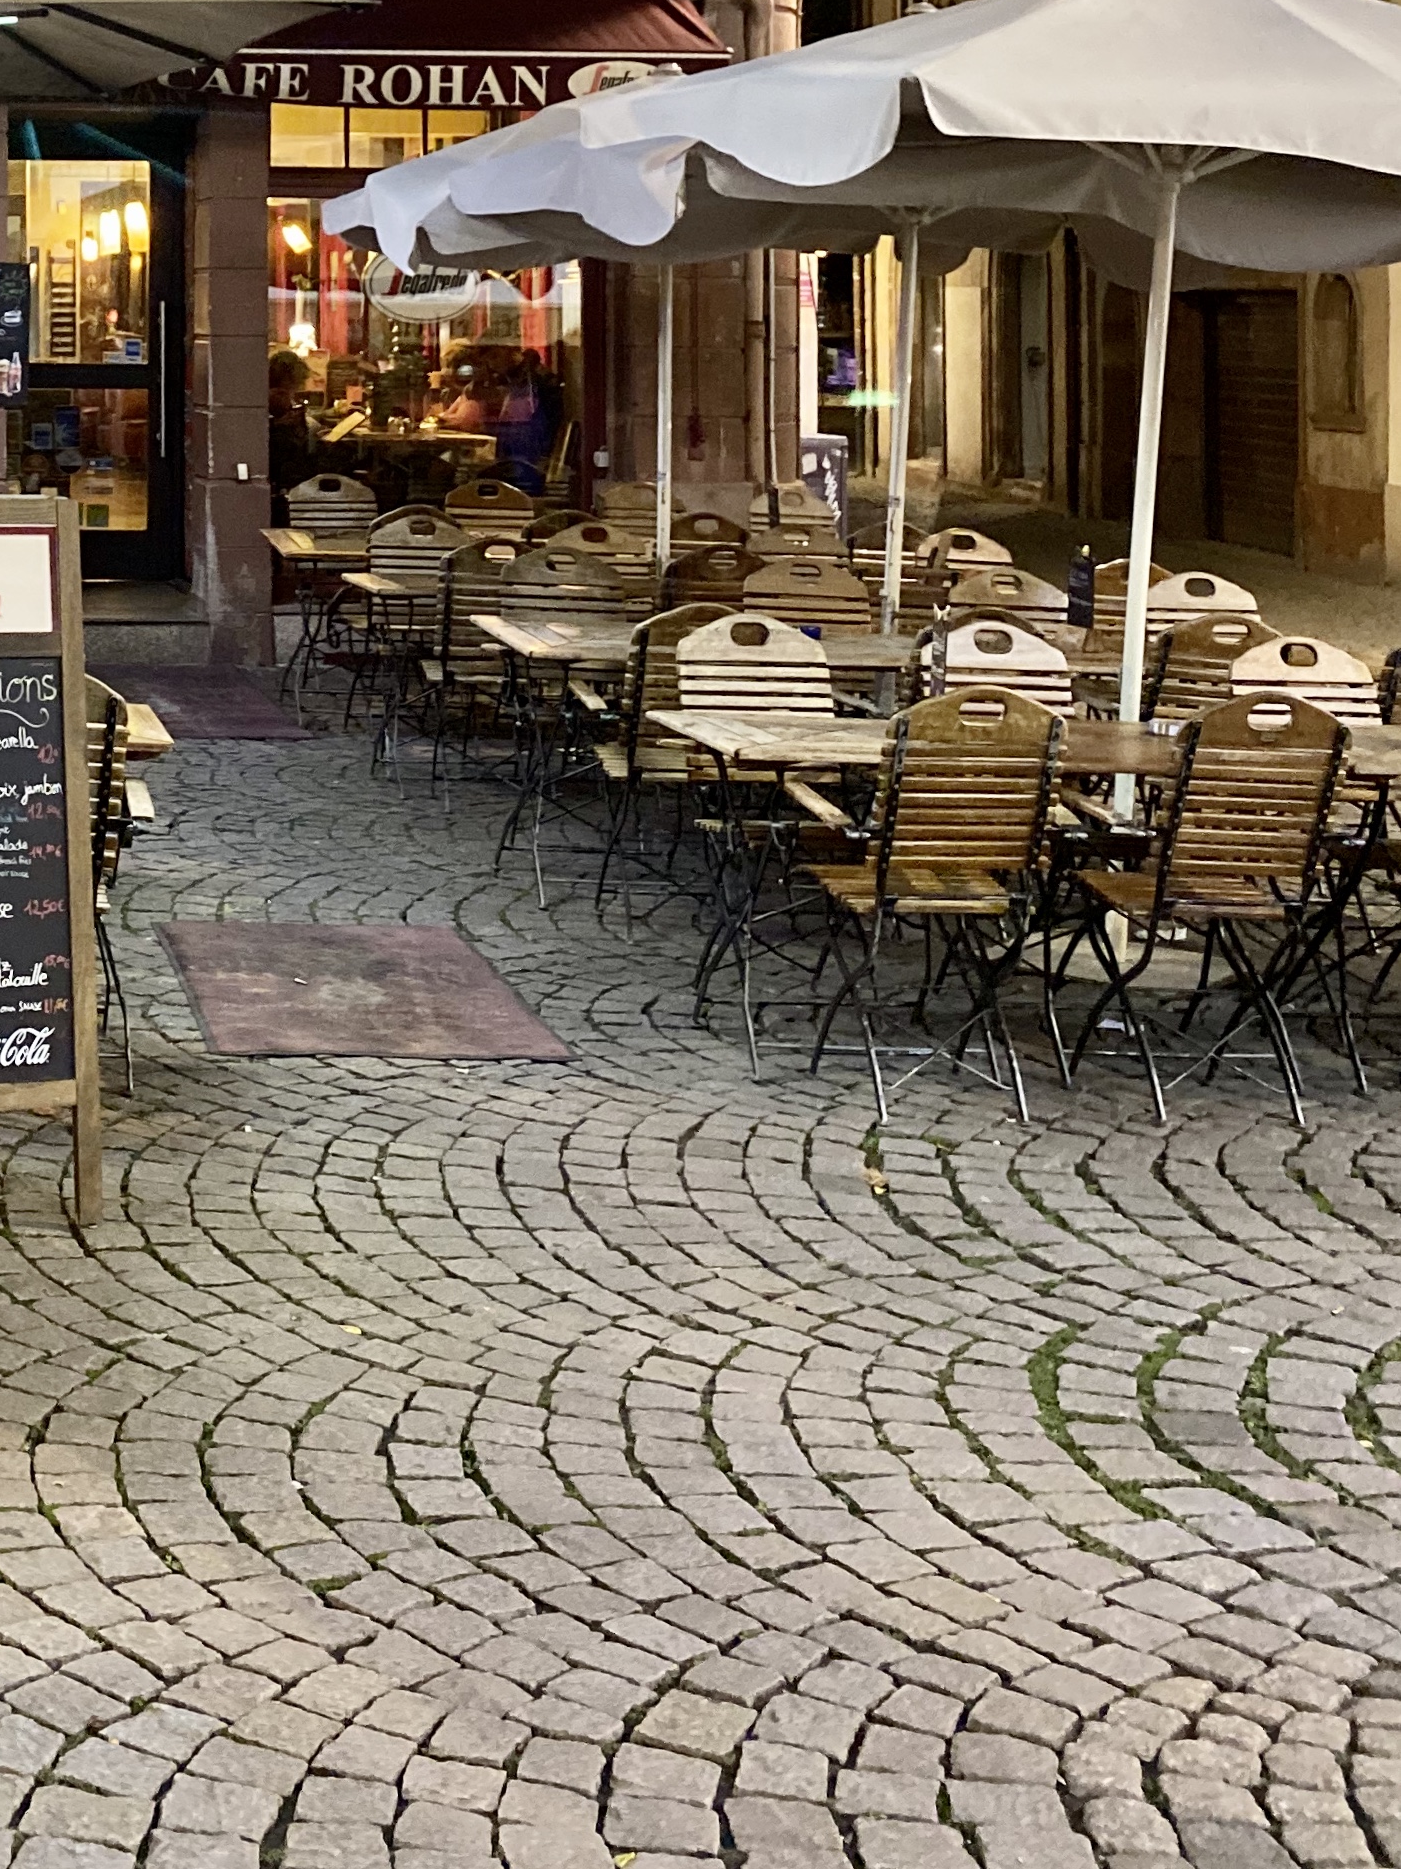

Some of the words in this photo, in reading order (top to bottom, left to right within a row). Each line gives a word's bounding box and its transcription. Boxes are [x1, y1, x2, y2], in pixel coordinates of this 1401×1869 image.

[157, 62, 309, 102] CAFE
[341, 64, 551, 107] ROHAN
[21, 773, 63, 806] jambon
